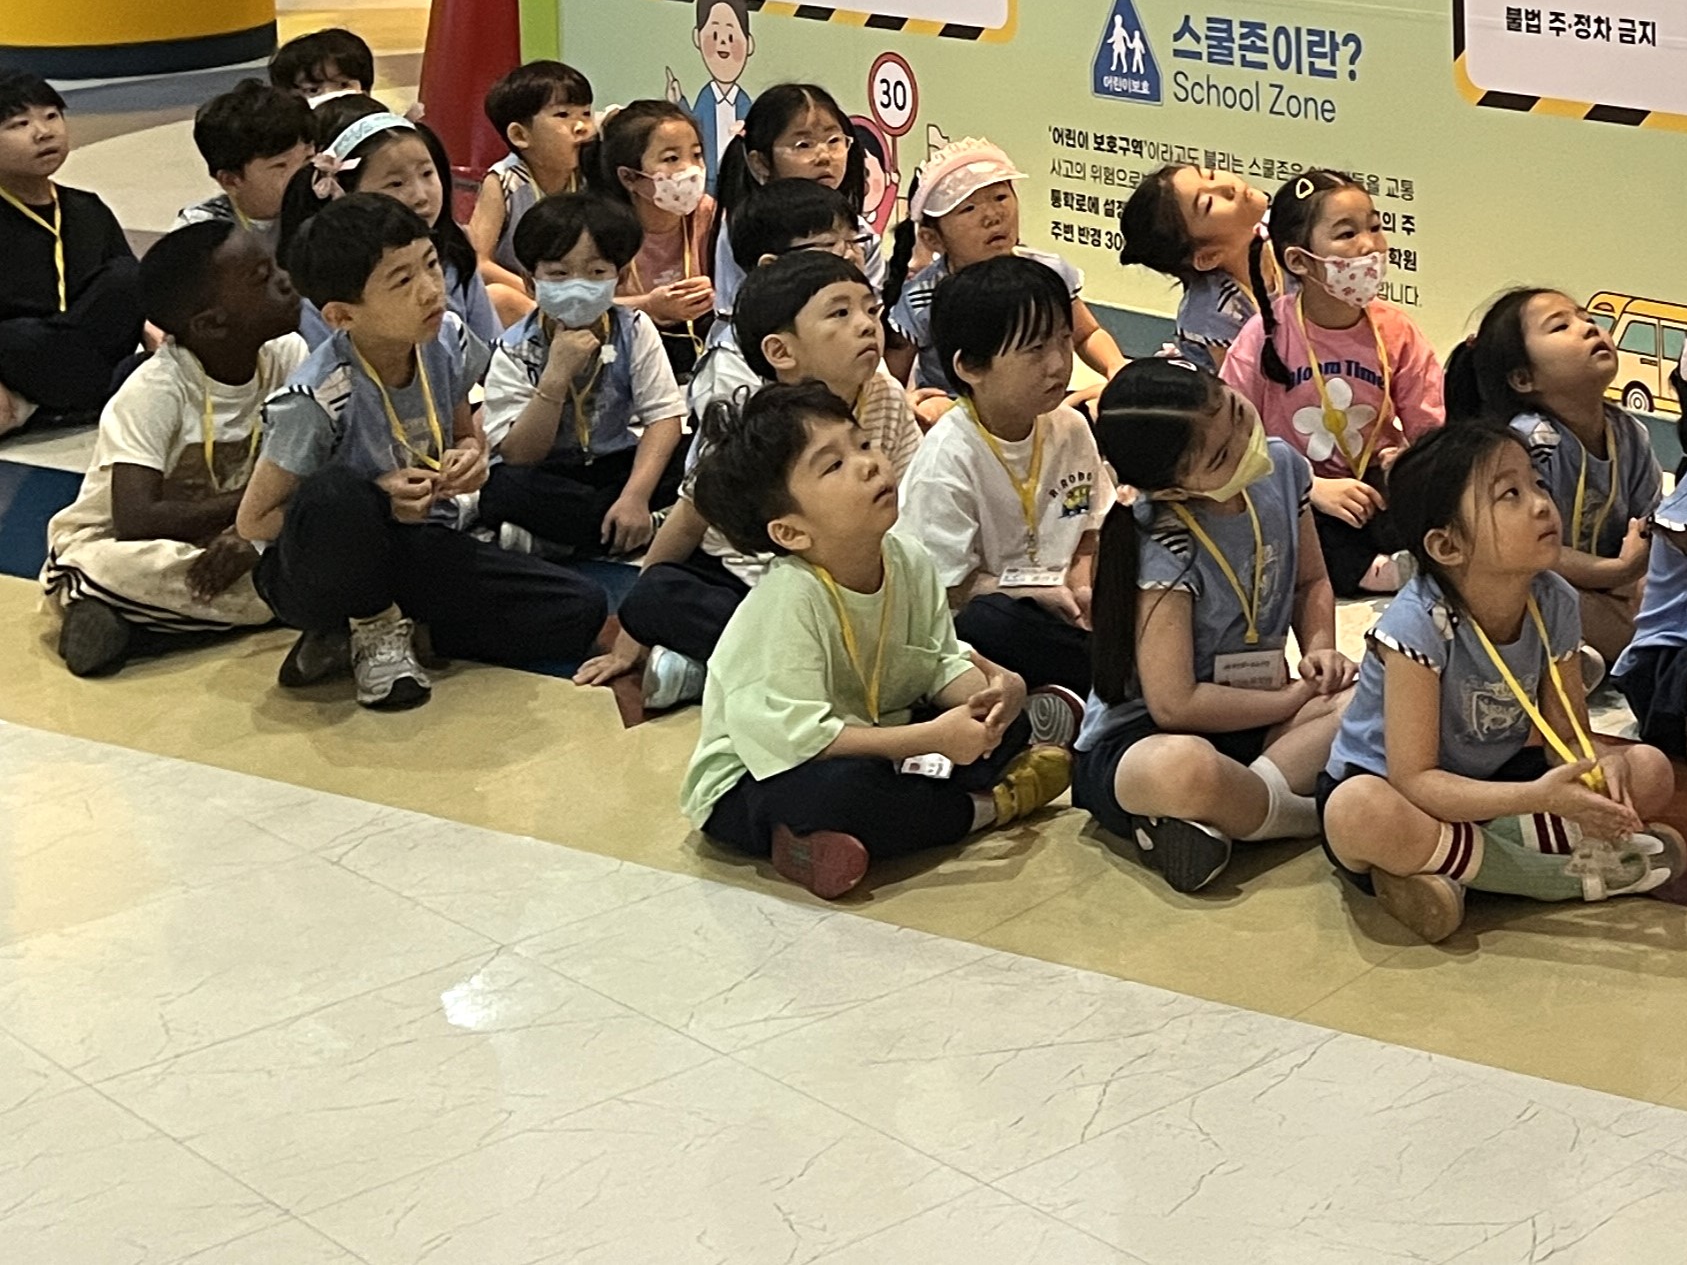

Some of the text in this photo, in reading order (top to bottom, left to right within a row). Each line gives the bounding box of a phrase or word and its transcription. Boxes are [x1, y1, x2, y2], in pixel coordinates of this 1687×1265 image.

[1505, 5, 1542, 35] 불법
[1617, 18, 1657, 47] 금지
[1172, 14, 1362, 82] 스쿨존이란?
[879, 78, 907, 112] 30
[1172, 70, 1337, 123] School Zone
[1050, 157, 1146, 190] 사고의 위험으로
[1204, 148, 1244, 175] 불리는
[1050, 188, 1127, 220] 통학로에 설정
[1385, 176, 1415, 202] 교통
[1051, 220, 1125, 252] 주변 반경 30
[1388, 246, 1418, 272] 학원
